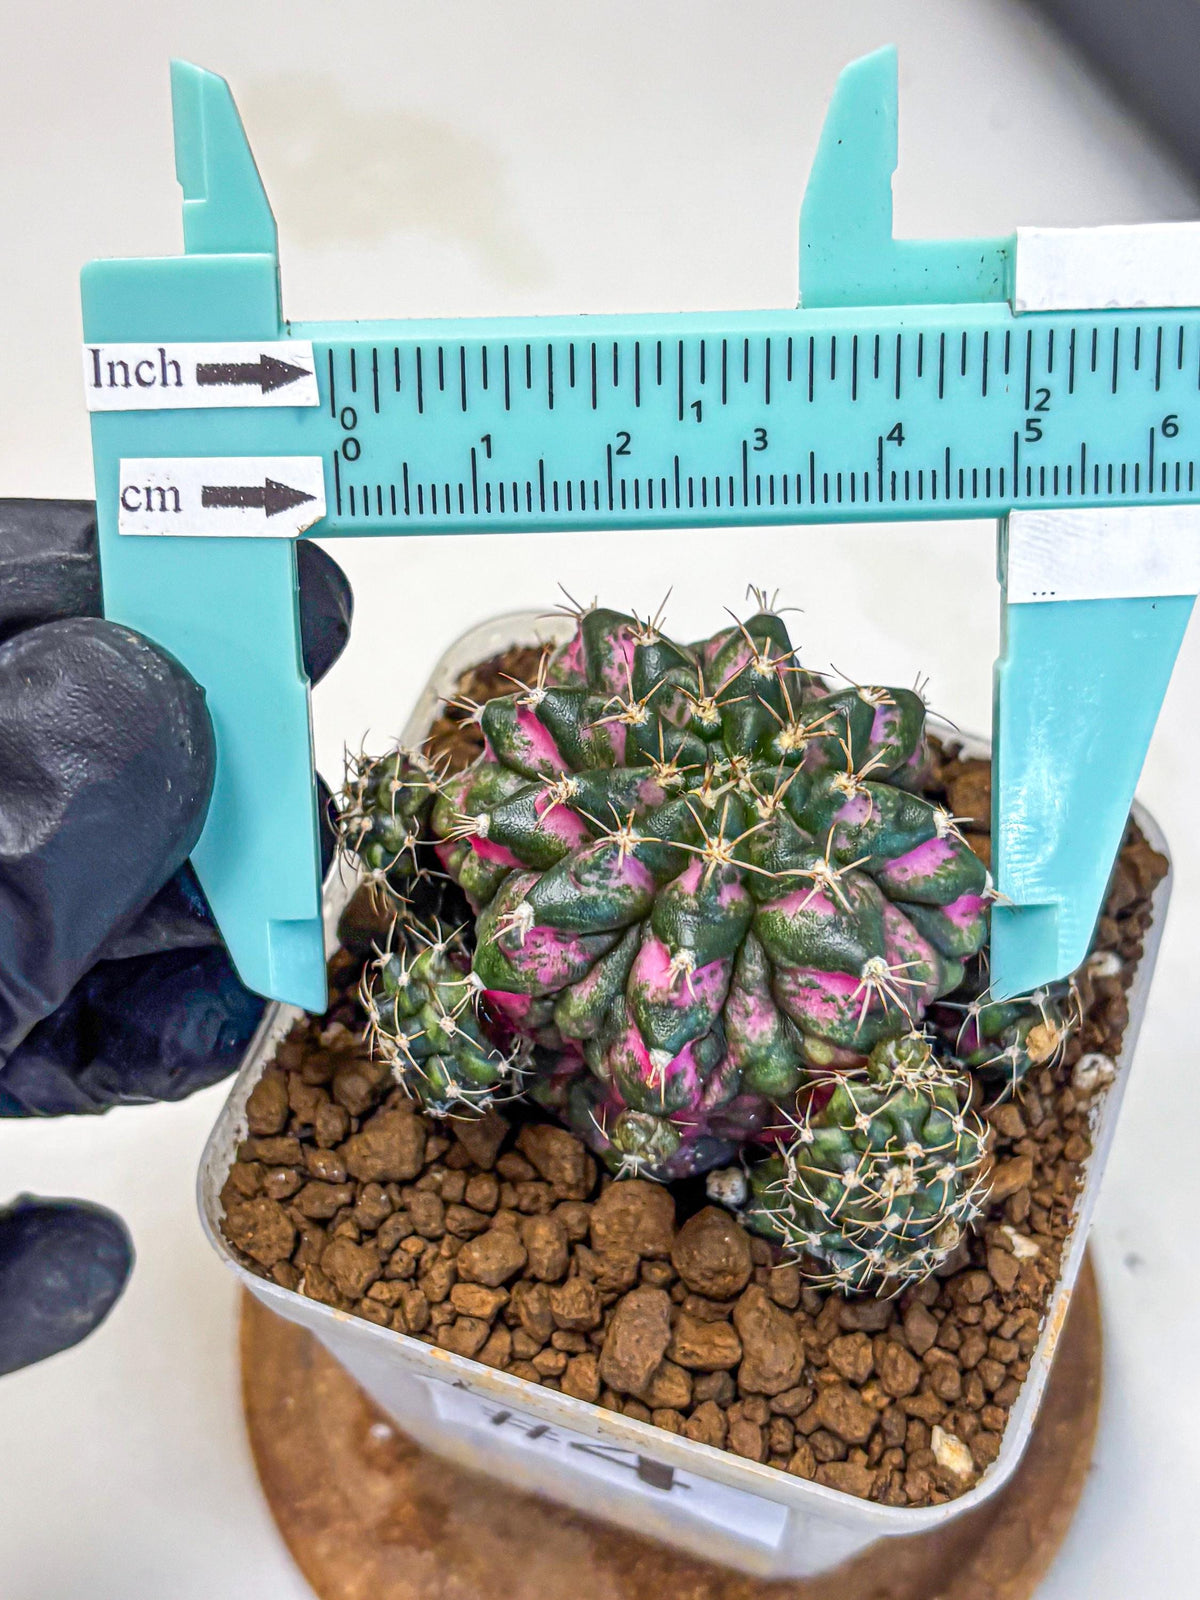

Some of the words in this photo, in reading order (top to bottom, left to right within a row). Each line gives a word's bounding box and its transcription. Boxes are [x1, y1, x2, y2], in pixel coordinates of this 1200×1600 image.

[87, 348, 183, 389] Inch
[340, 406, 358, 431] 0
[690, 400, 703, 423] 1
[1033, 387, 1051, 412] 2
[342, 437, 361, 462] 0
[480, 434, 492, 459] 1
[615, 431, 632, 456] 2
[753, 427, 769, 451] 3
[886, 423, 905, 447] 4
[1024, 418, 1043, 443] 5
[1161, 414, 1179, 439] 6
[120, 485, 183, 513] cm
